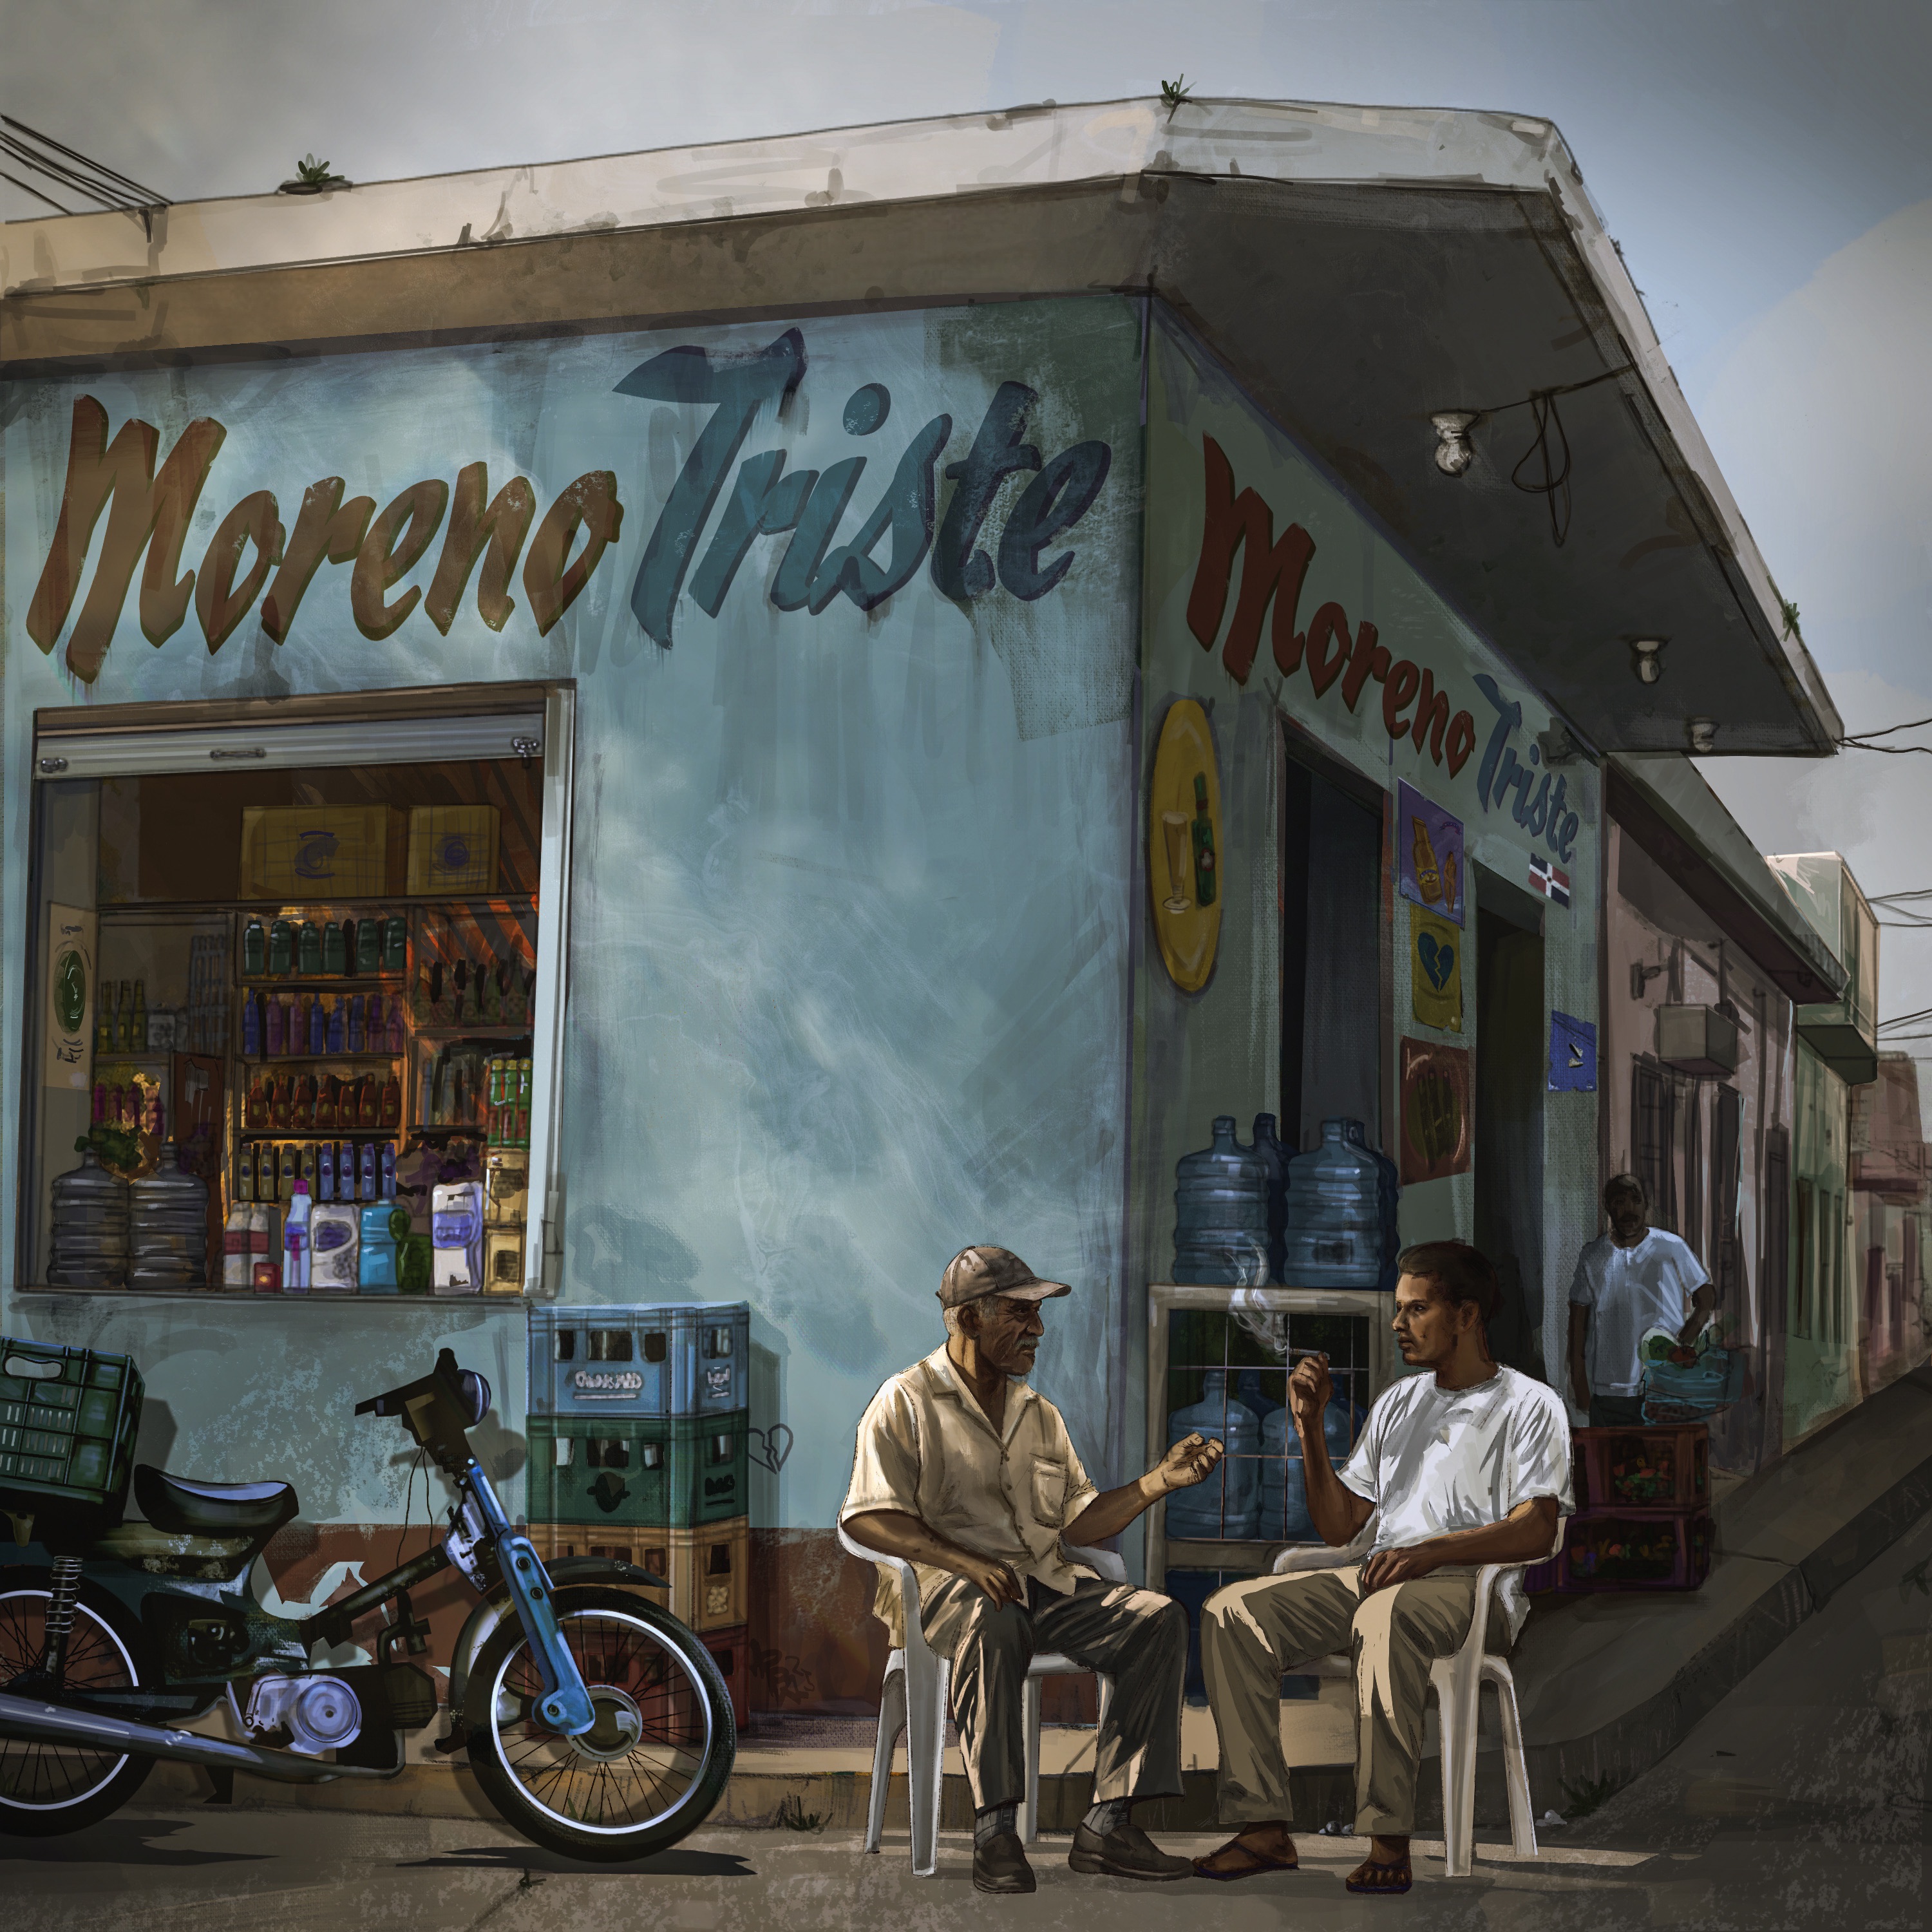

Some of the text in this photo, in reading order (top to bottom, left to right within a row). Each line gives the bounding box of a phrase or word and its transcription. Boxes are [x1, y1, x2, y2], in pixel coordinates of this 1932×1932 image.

[26, 327, 1111, 684] Moreno Triste
[1186, 430, 1578, 863] Moreno Triste
